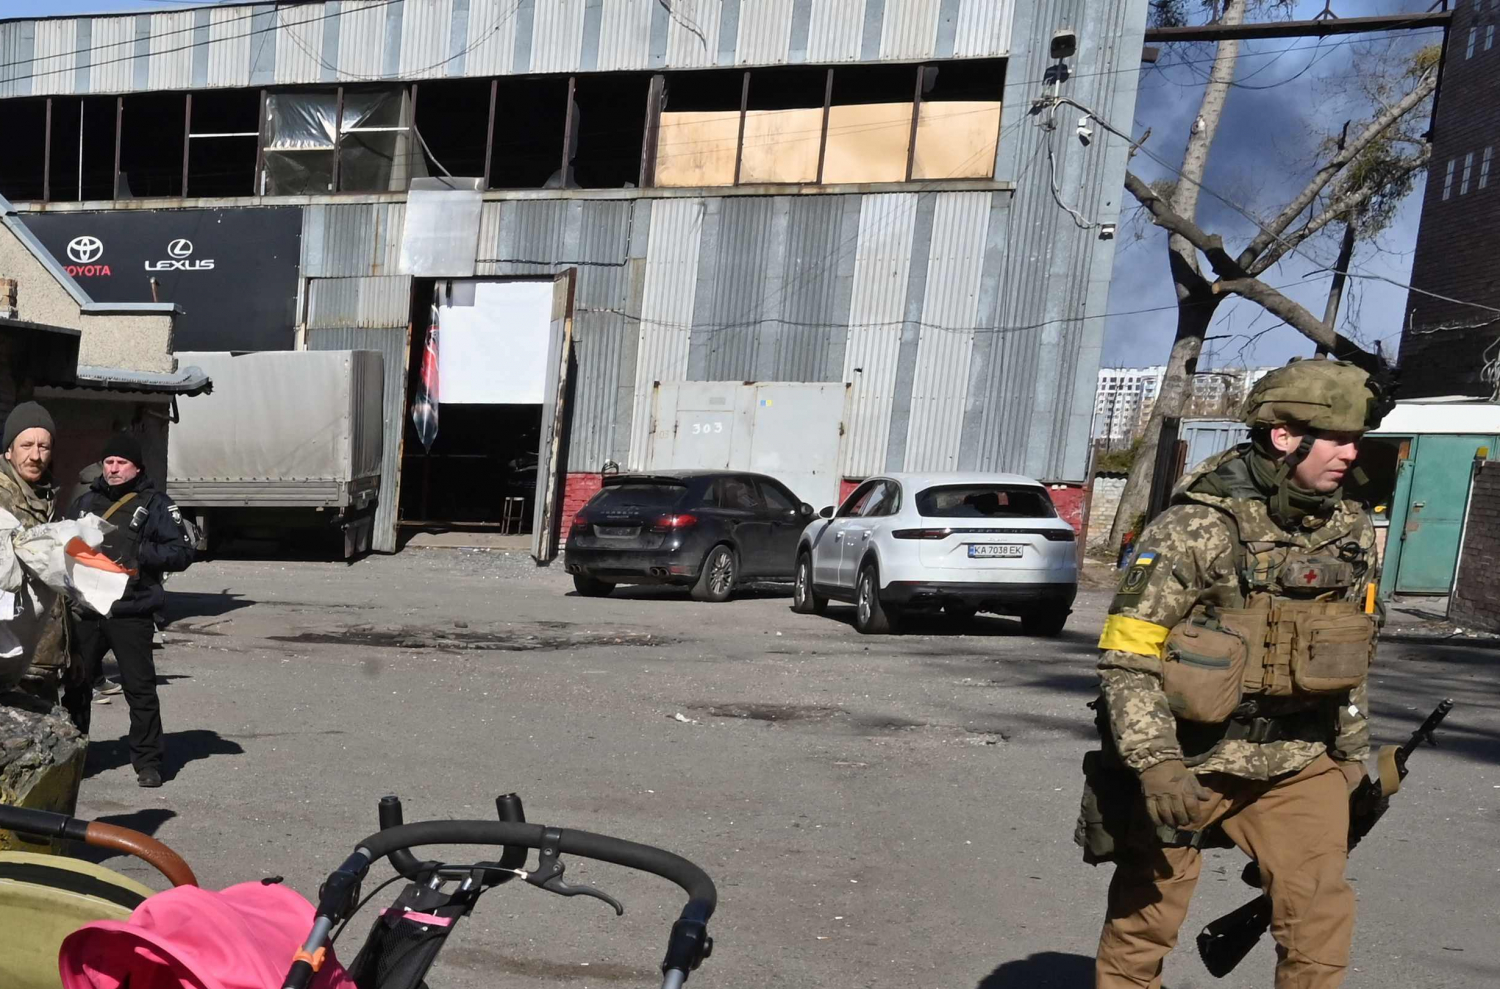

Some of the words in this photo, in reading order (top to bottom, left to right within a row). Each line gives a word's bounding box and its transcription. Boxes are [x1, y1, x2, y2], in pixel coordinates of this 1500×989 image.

[62, 264, 112, 277] OYOTA
[144, 259, 215, 271] LEXUS
[691, 421, 723, 435] 303
[974, 544, 987, 554] KA
[988, 544, 1008, 554] 7038
[1009, 544, 1022, 554] EK
